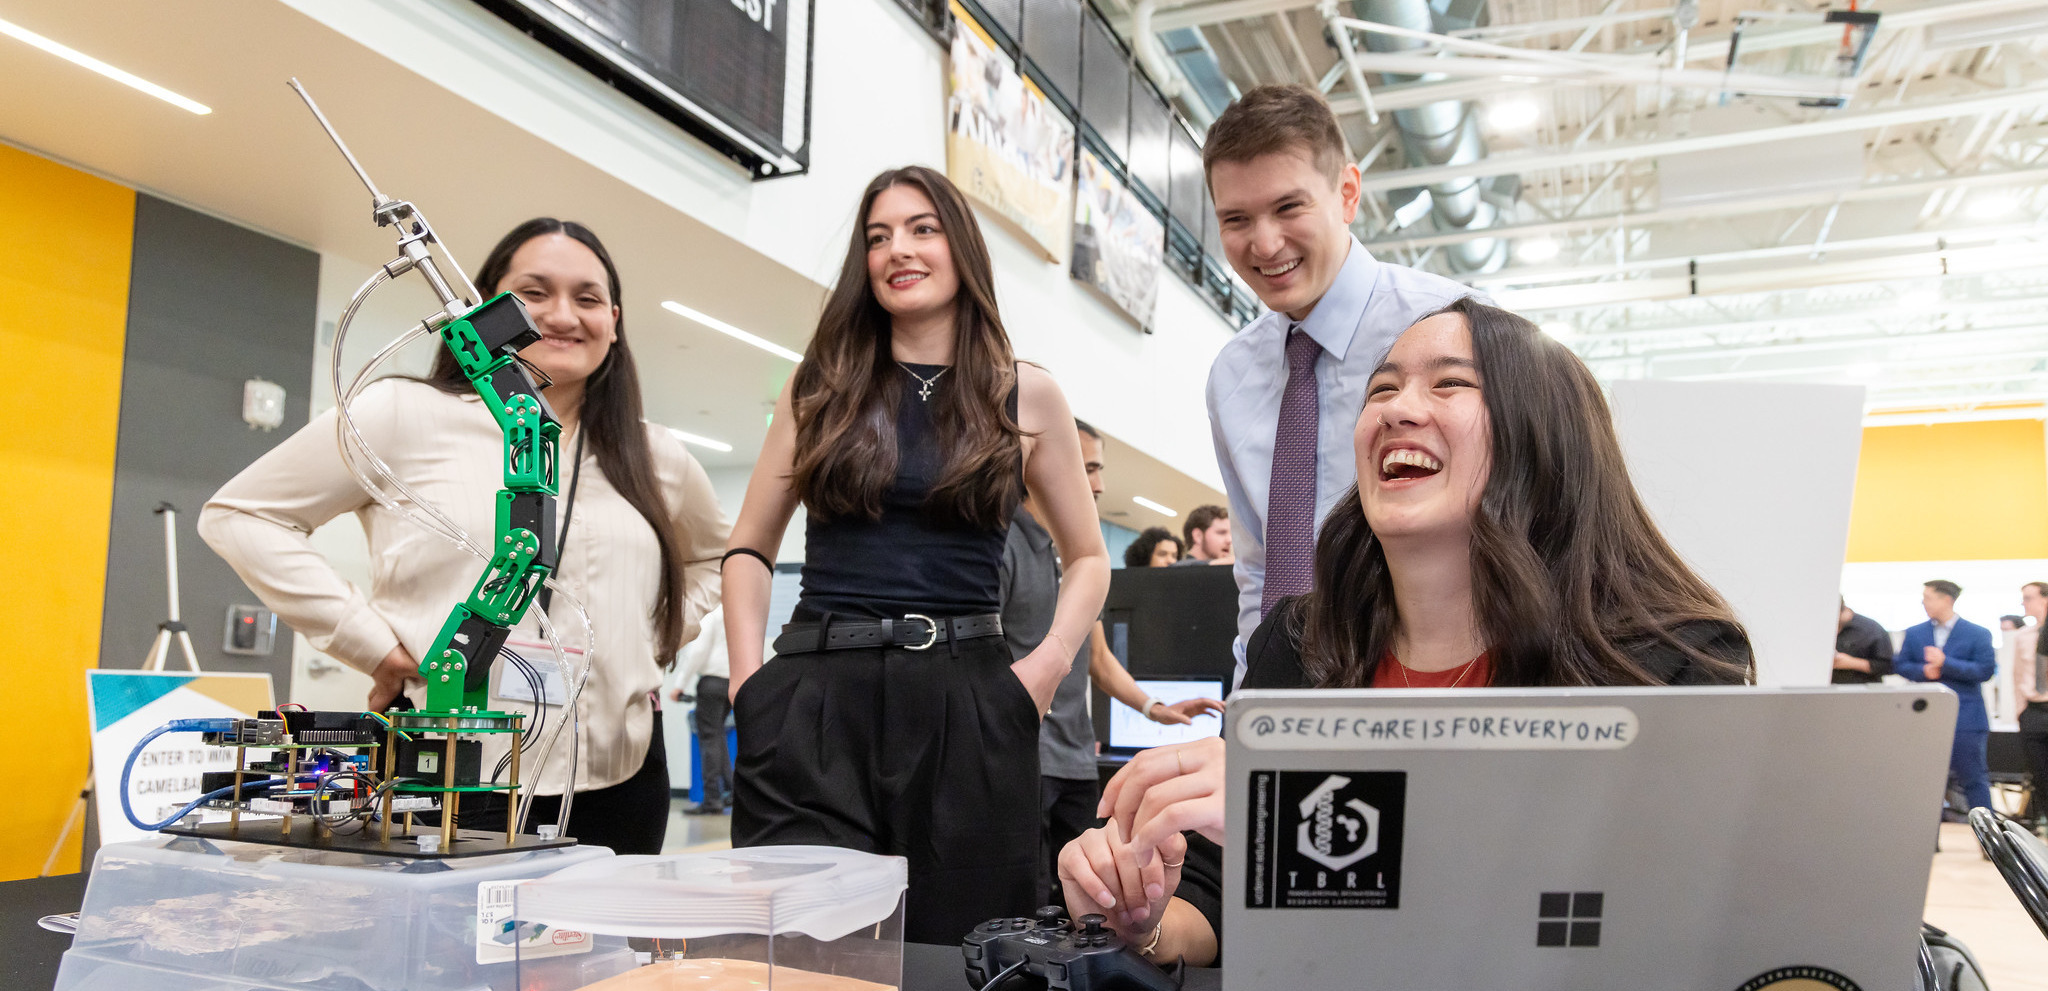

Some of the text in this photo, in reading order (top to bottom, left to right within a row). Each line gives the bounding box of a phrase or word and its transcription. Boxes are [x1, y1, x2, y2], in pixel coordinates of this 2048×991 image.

[1250, 715, 1628, 742] @SELFCAREISFOREVERYONE
[142, 749, 232, 767] ENTER TO WIN
[425, 758, 430, 768] 1
[136, 777, 201, 794] CAMELBA
